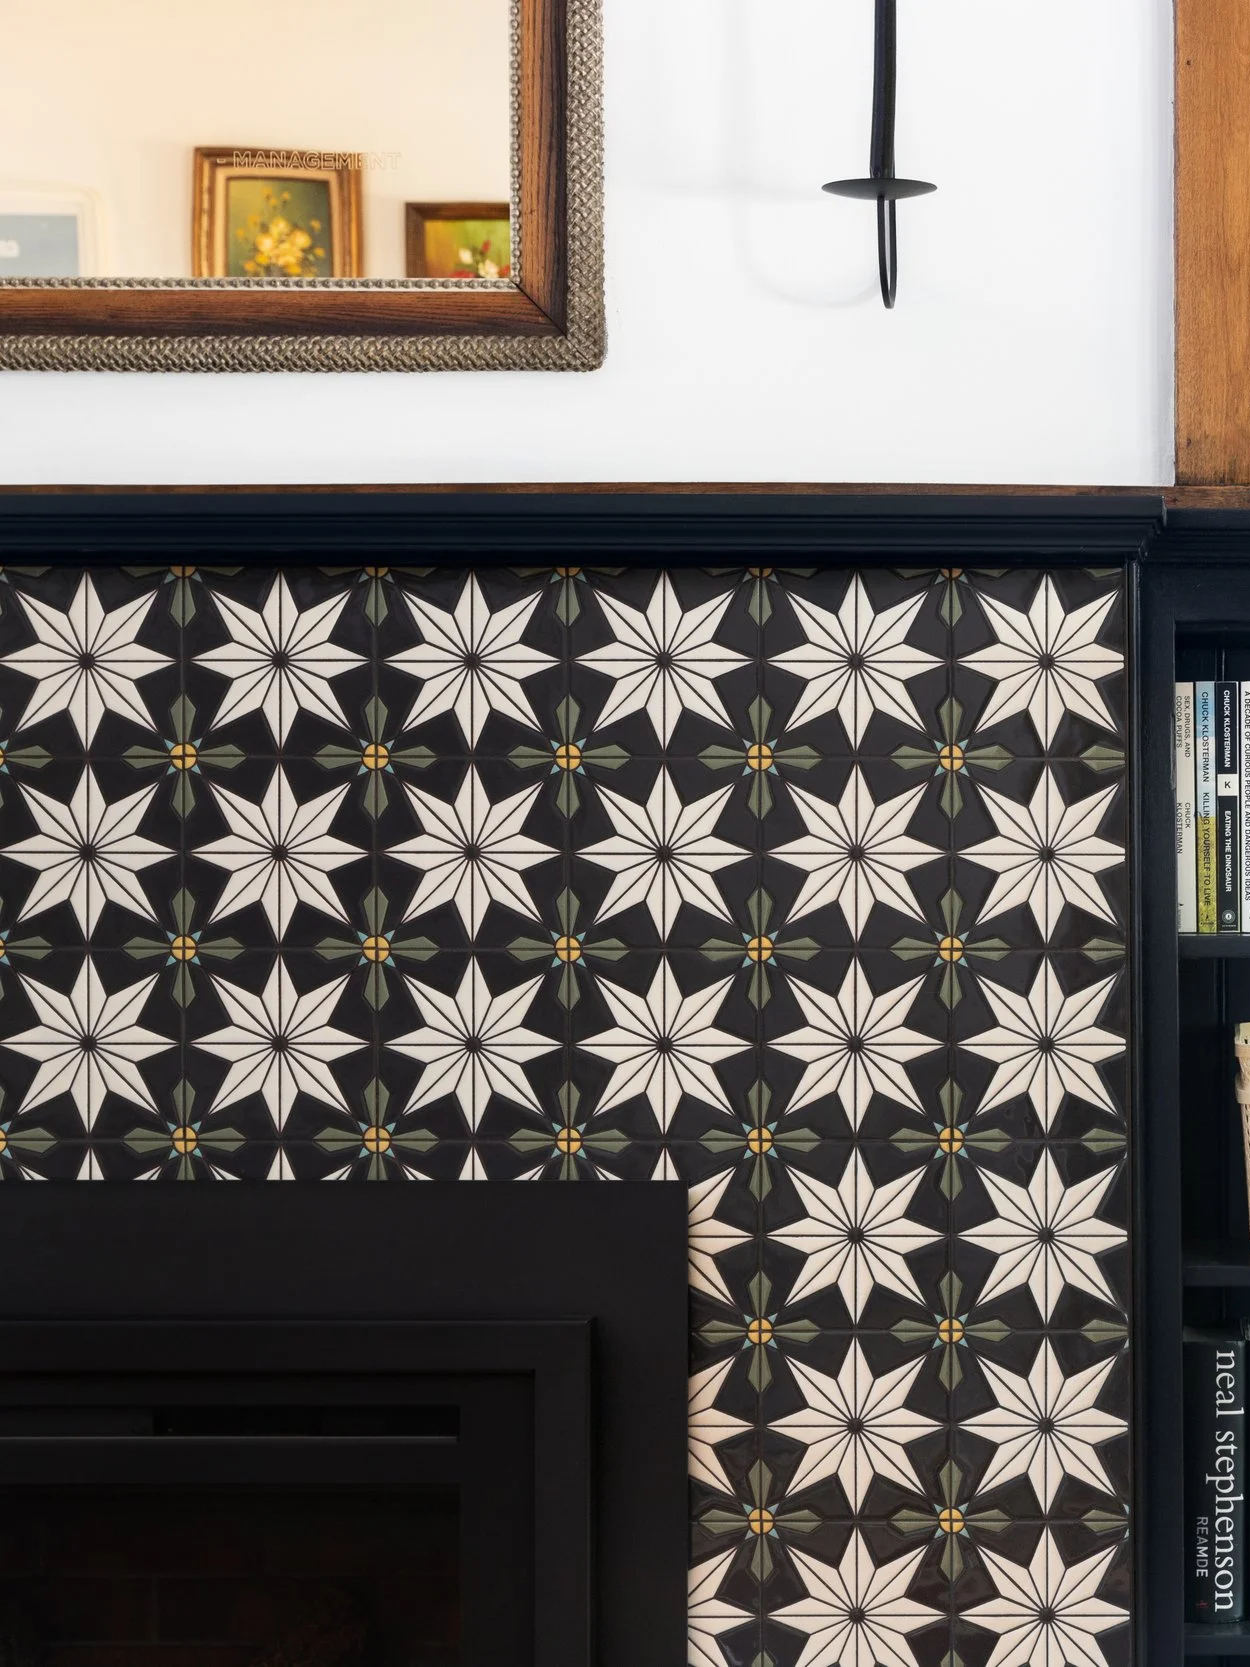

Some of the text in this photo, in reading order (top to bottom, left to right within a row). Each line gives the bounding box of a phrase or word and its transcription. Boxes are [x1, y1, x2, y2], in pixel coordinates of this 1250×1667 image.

[1201, 692, 1209, 722] CHUCK
[1245, 730, 1250, 742] OF
[1203, 828, 1211, 871] YOURSELF
[1204, 874, 1210, 886] TO
[1206, 1350, 1244, 1612] neal stephenson
[1196, 1517, 1208, 1577] REAMDE
